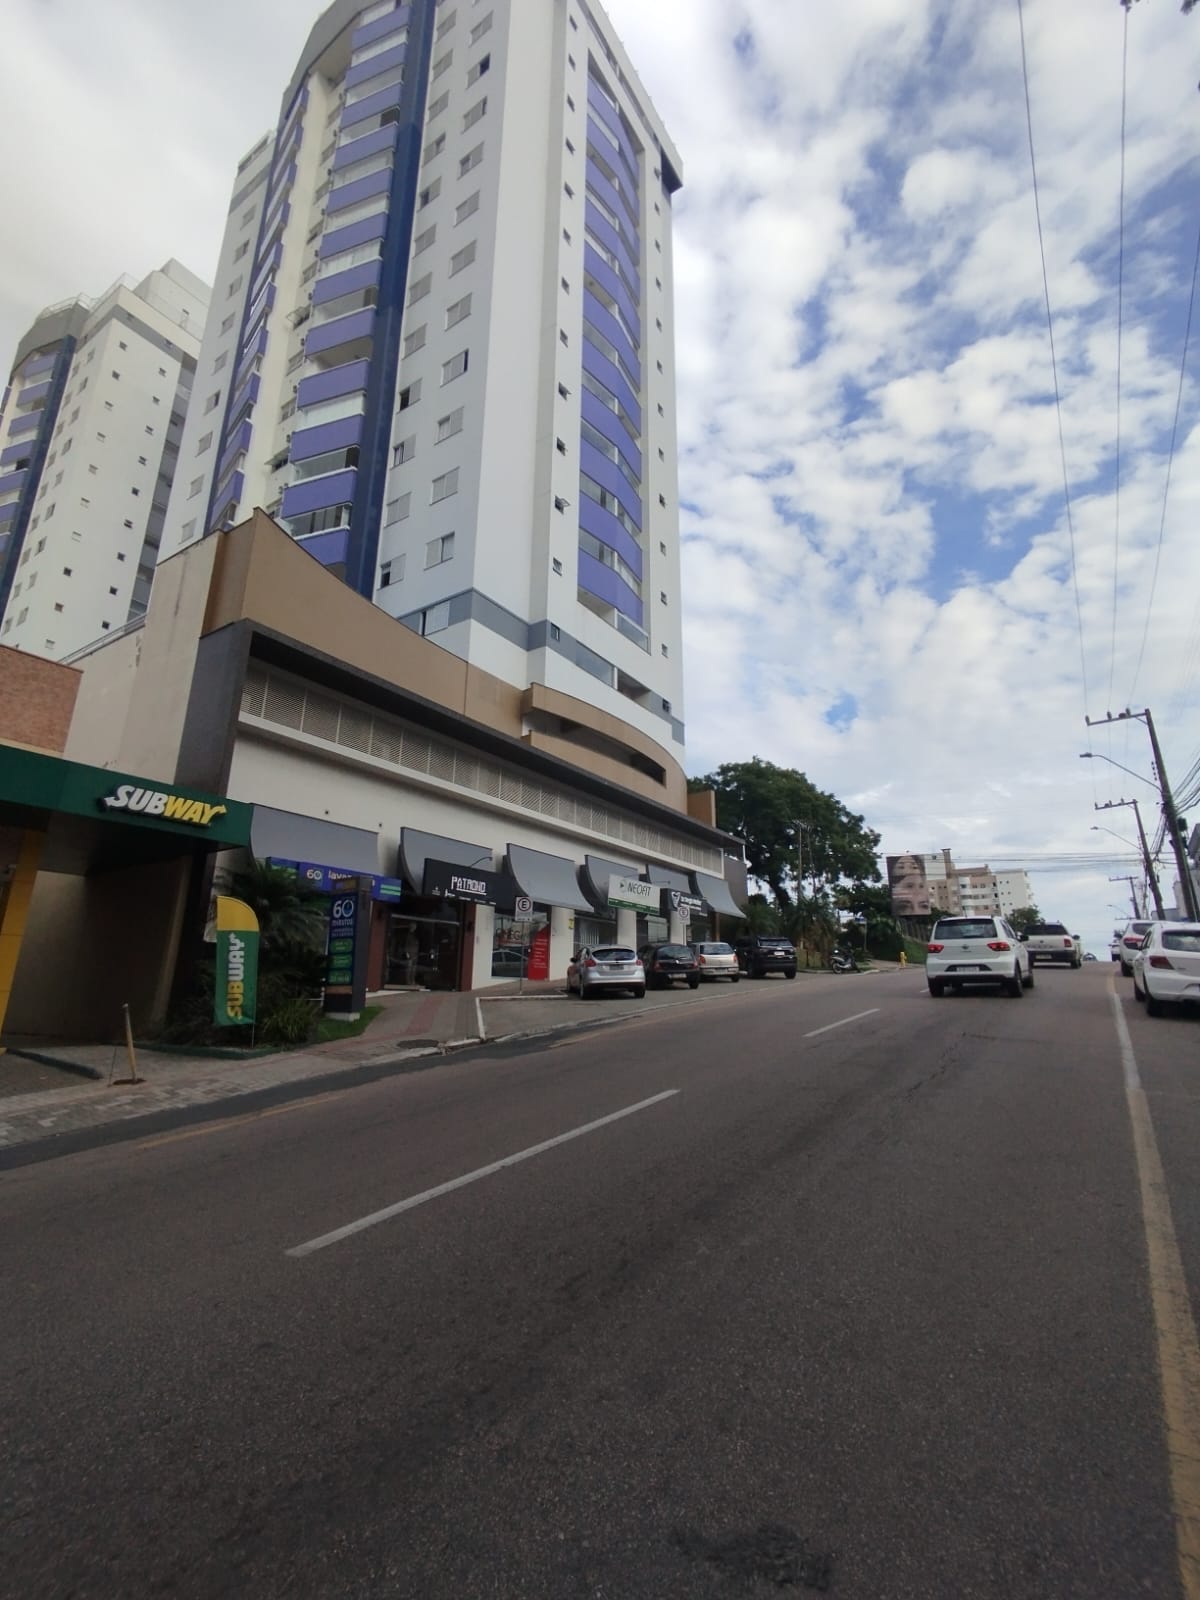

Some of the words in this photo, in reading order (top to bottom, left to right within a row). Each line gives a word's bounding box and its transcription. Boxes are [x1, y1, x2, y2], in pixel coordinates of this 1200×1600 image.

[104, 785, 227, 825] SUBWAY
[306, 869, 322, 880] 60
[333, 899, 354, 918] 60
[521, 900, 527, 909] E
[227, 932, 245, 1020] SUBWAY
